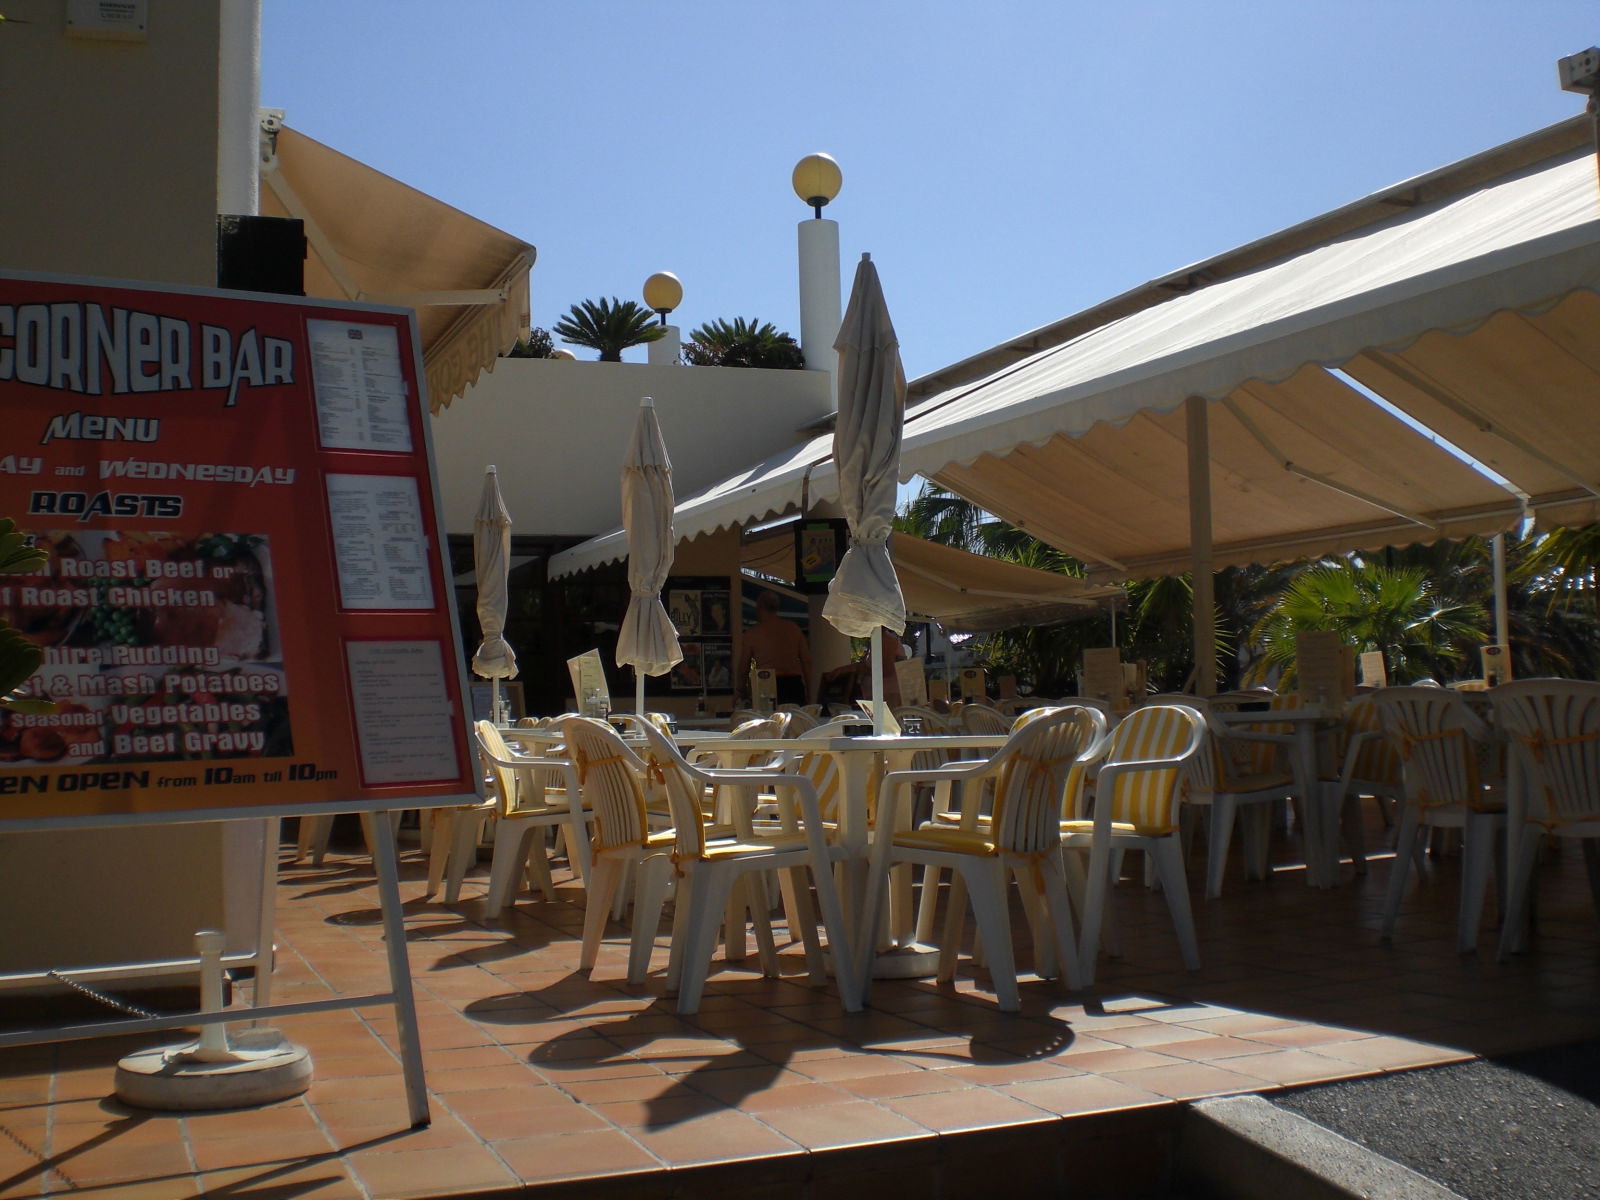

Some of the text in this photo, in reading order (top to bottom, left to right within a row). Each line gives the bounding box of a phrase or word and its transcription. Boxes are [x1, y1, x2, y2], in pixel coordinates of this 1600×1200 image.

[199, 322, 295, 408] BAR
[54, 466, 85, 477] and
[27, 489, 184, 521] ROASTS
[61, 558, 137, 577] Roast
[145, 559, 203, 579] Beef
[212, 566, 233, 579] or
[21, 586, 99, 606] Roast
[108, 587, 215, 607] Chicken
[111, 645, 219, 666] Pudding
[50, 674, 72, 697] &
[78, 673, 155, 697] Mash
[164, 672, 280, 695] Potatoes
[10, 702, 261, 728] Seasonal Vegetables
[69, 731, 265, 756] and Beef Gravy
[156, 776, 198, 789] from
[263, 770, 284, 783] till
